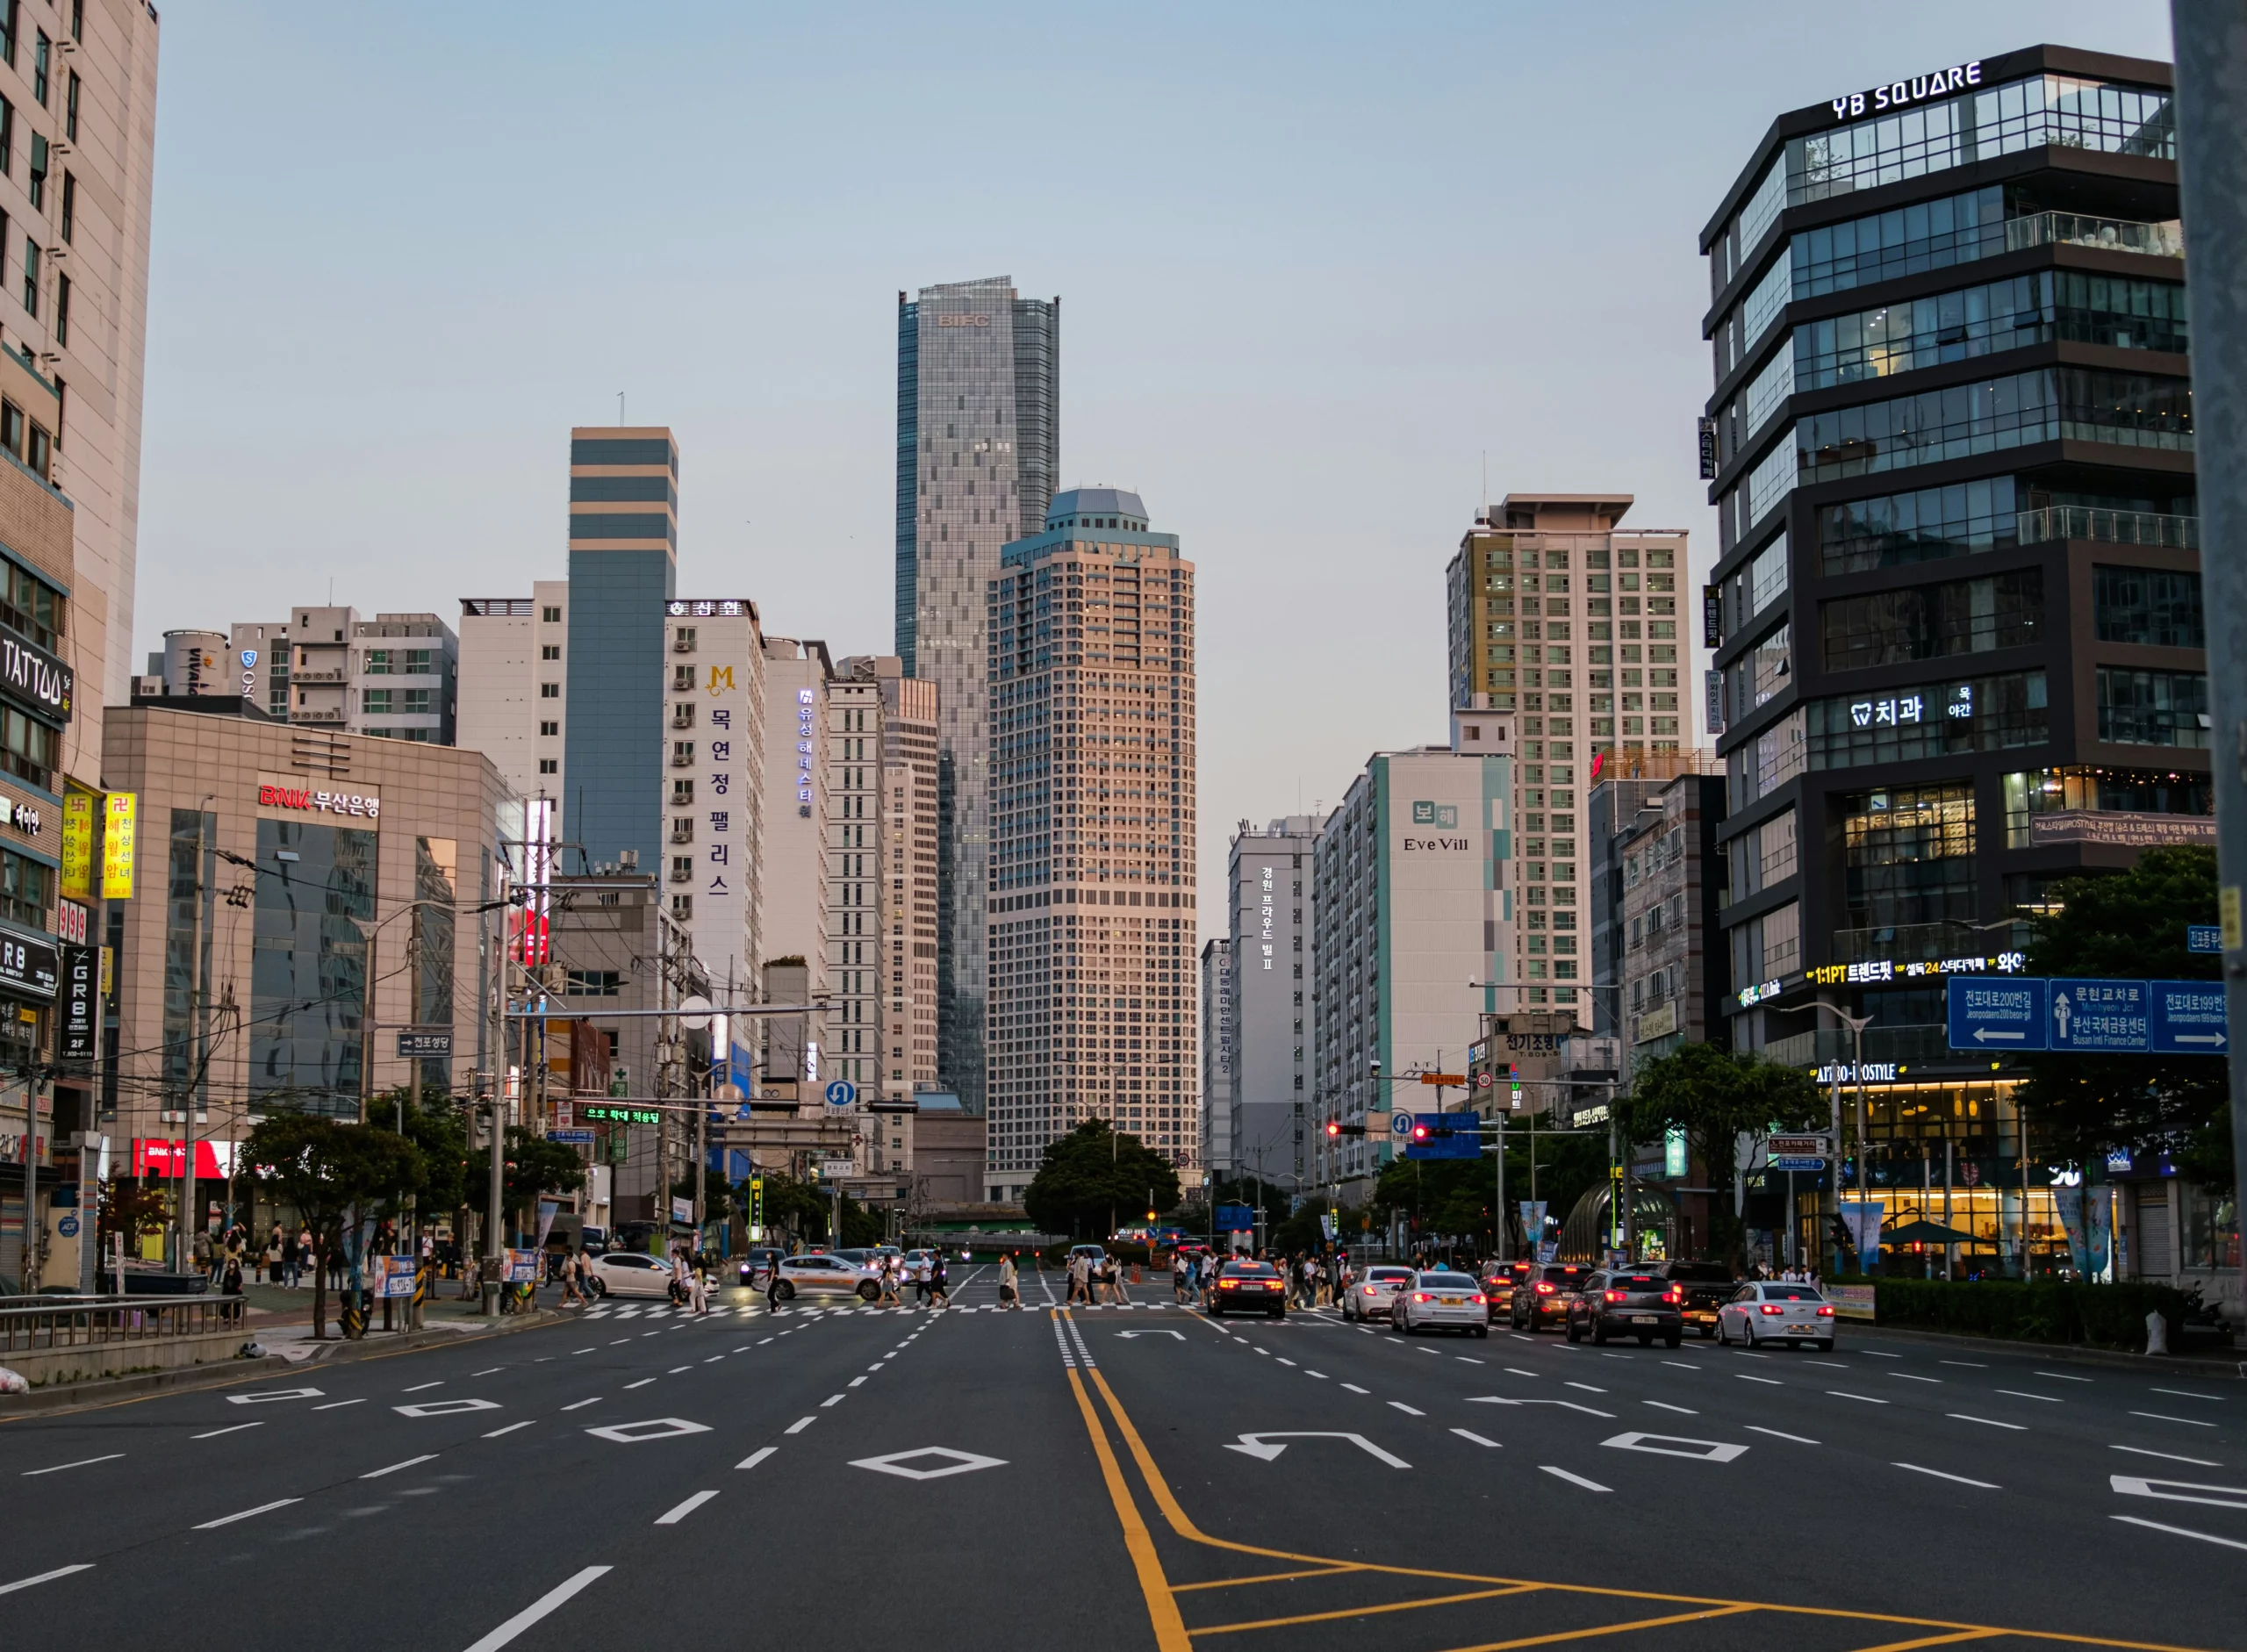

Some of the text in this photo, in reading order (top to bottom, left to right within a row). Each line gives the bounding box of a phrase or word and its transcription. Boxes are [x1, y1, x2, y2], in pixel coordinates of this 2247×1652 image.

[1833, 61, 1981, 120] YB SQUARE
[938, 315, 989, 327] BIFC
[1707, 599, 1718, 639] 트렌드핏
[4, 639, 61, 705] TATTOO
[1959, 686, 1971, 700] 목
[1876, 695, 1923, 726] 치과
[1949, 703, 1971, 718] 야간
[261, 785, 380, 818] BNK 부산은행
[708, 709, 731, 895] 목연정팰리스
[1416, 805, 1454, 825] 보해
[119, 818, 132, 879] 천상선녀
[1403, 838, 1468, 851] Eve Vill
[1262, 895, 1273, 939] 프라우드
[1262, 945, 1273, 957] 빌
[1815, 965, 1847, 984] 1:1PT
[1847, 960, 1892, 982] 트렌드핏
[72, 966, 88, 1016] GR8
[1965, 990, 2031, 1008] 전포대로200번길
[2076, 987, 2139, 1002] 문현교차로
[2057, 1008, 2068, 1017] 71
[2072, 1016, 2146, 1034] 부산국제금융센터
[71, 1039, 84, 1048] 2F
[414, 1037, 449, 1049] 전포성당
[1506, 1034, 1554, 1051] 전기조명
[2072, 1035, 2093, 1045] Busan
[2104, 1036, 2127, 1045] Finance
[2127, 1036, 2146, 1046] Center
[587, 1109, 606, 1118] 으로
[610, 1110, 628, 1121] 확대
[148, 1147, 169, 1156] BNK
